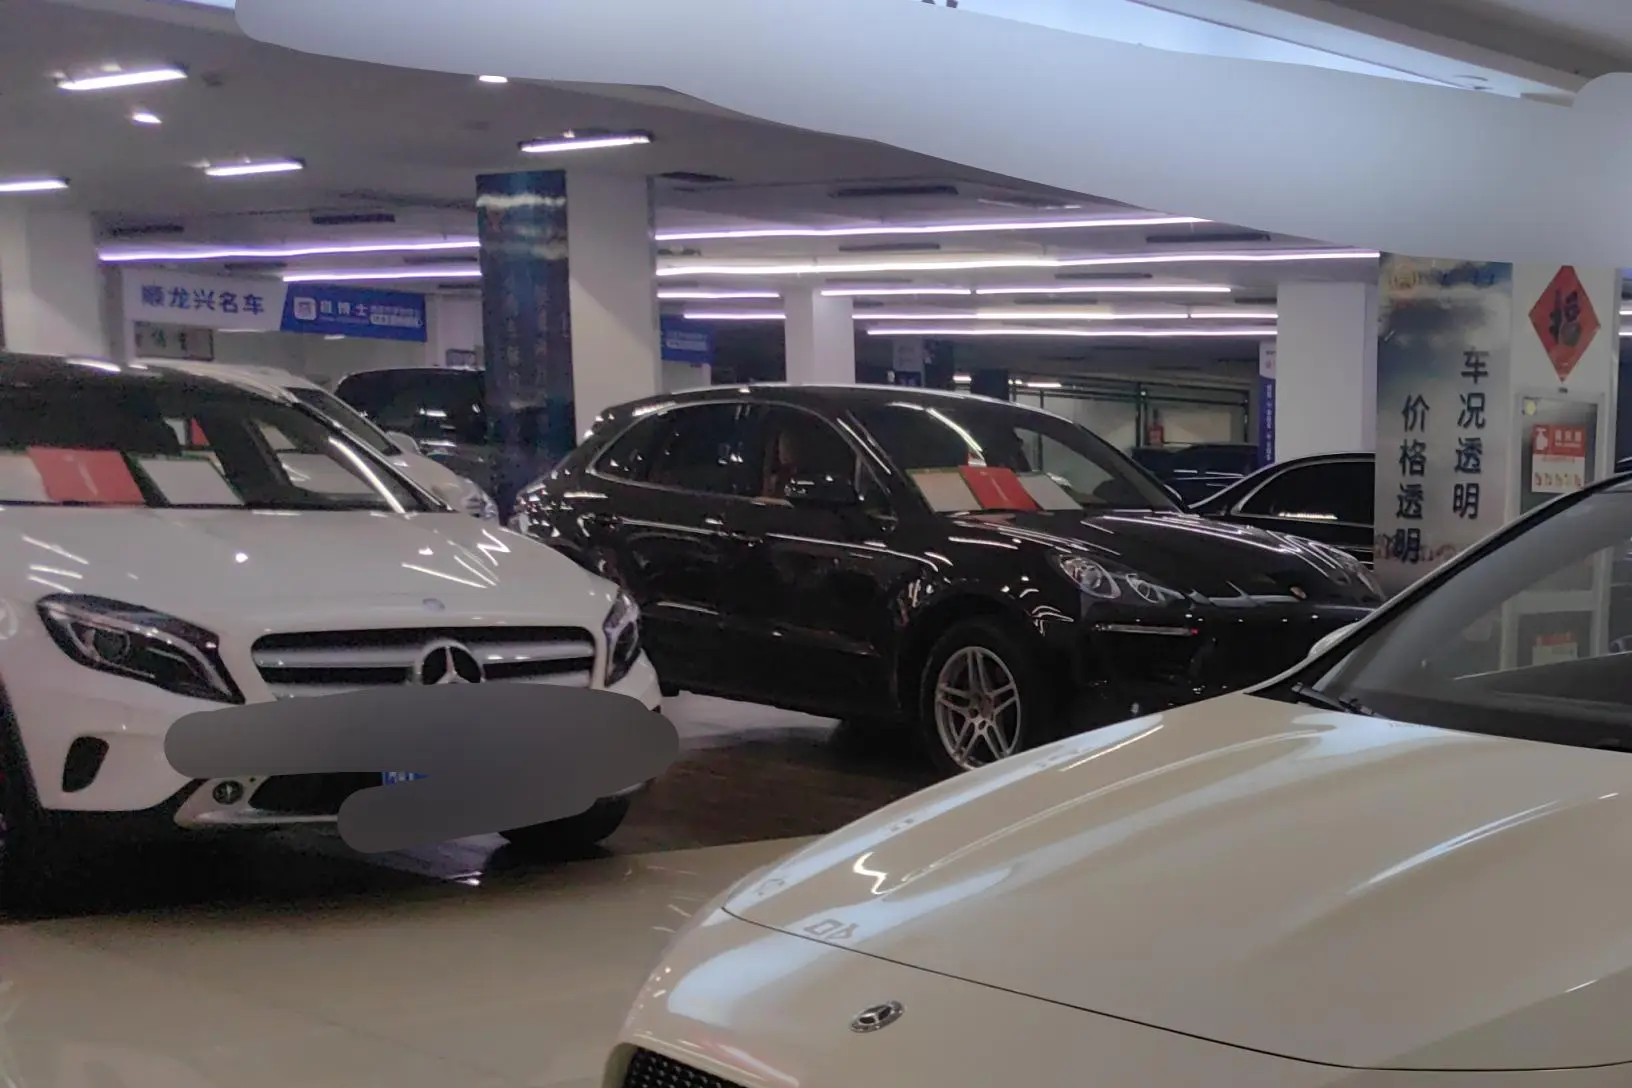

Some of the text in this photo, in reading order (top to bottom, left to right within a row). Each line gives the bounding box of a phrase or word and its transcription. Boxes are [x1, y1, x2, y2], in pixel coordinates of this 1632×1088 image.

[141, 284, 264, 315] 顺龙兴名车
[1395, 394, 1430, 564] 价格透明
[1453, 346, 1489, 520] 车况透明
